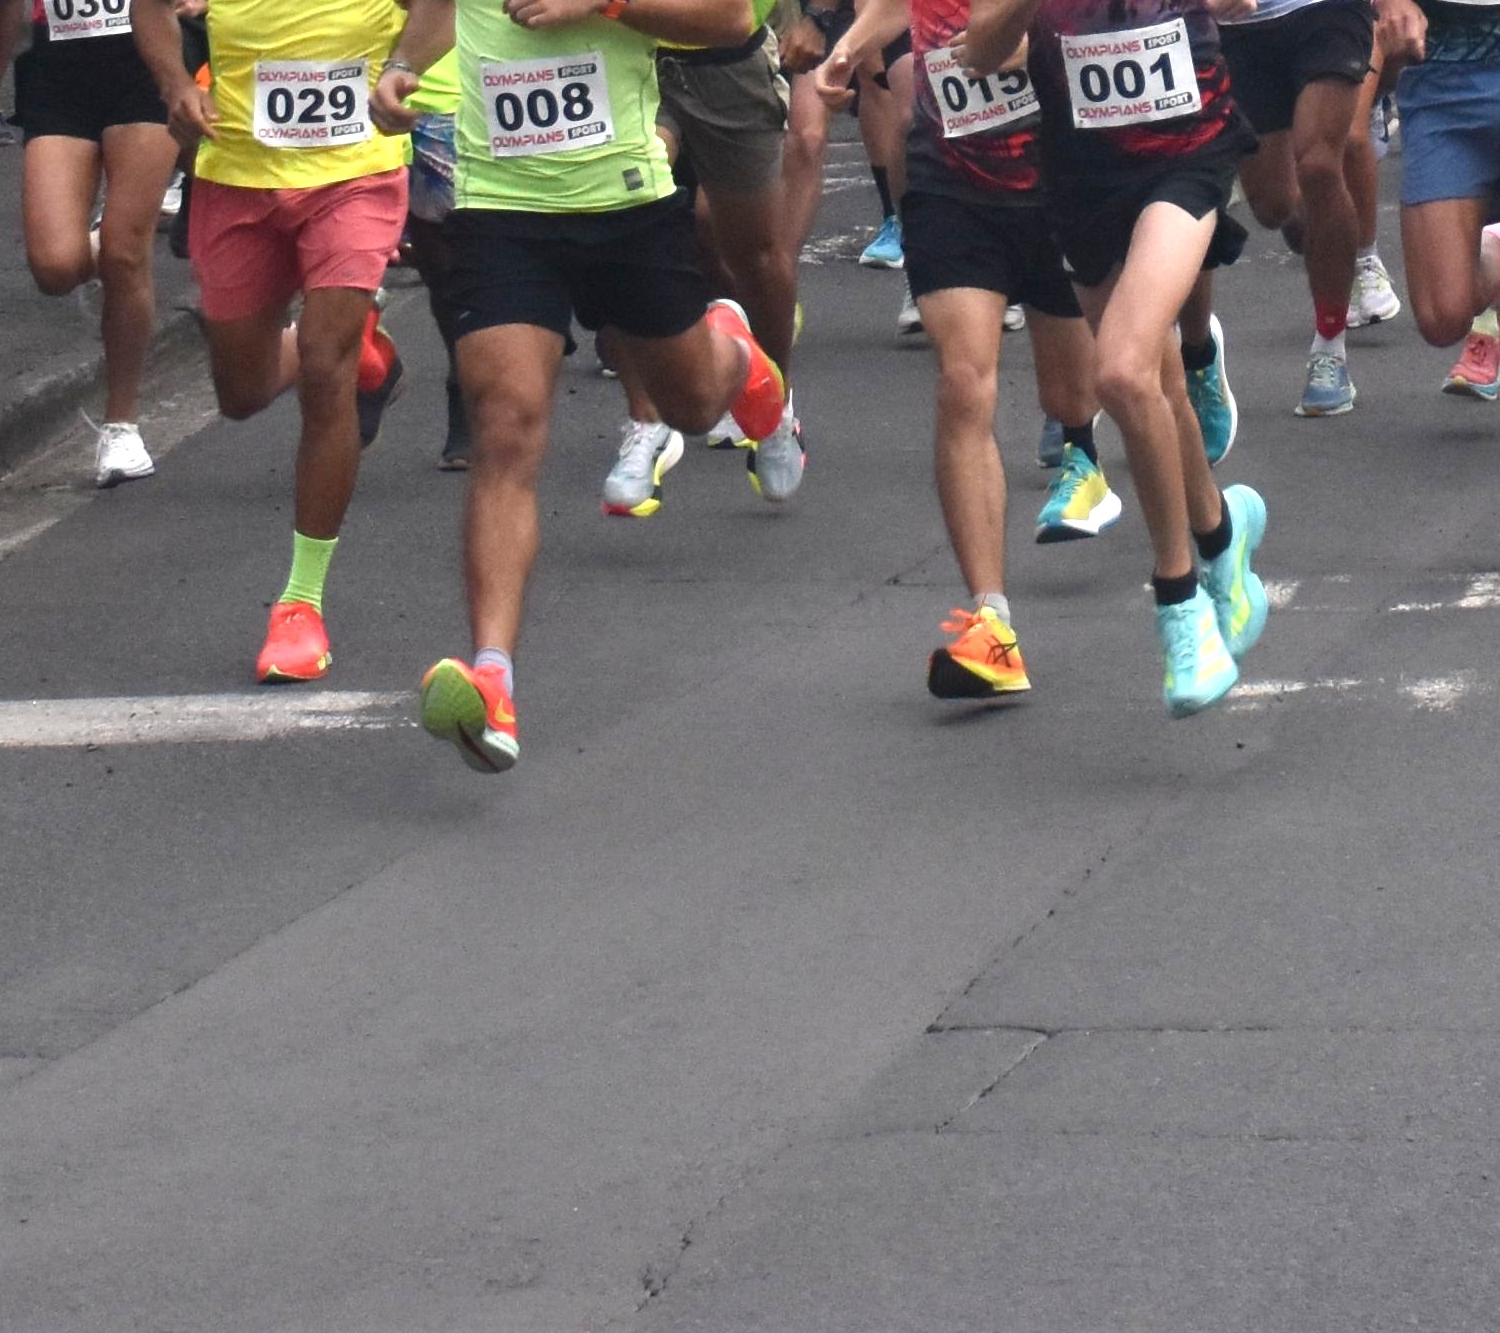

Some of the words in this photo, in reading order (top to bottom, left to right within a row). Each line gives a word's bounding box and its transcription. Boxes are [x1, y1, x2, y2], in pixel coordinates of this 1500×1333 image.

[52, 19, 105, 34] OLYMPIANS
[1066, 41, 1141, 60] OLYMPIANS
[1147, 31, 1179, 48] SPORT
[258, 71, 326, 82] OLYMPIANS
[331, 68, 360, 81] SPORT
[484, 69, 555, 87] OLYMPIANS
[561, 64, 593, 78] SPORT
[1079, 52, 1176, 103] 001
[941, 66, 1029, 114] 015
[267, 85, 356, 124] 029
[495, 82, 594, 132] 008
[946, 103, 1007, 132] OLYMPIANS
[1077, 101, 1152, 120] OLYMPIANS
[1156, 93, 1190, 110] SPORT
[258, 127, 328, 138] OLYMPIANS
[333, 123, 363, 136] SPORT
[492, 130, 565, 149] OLYMPIANS
[571, 123, 602, 138] SPORT
